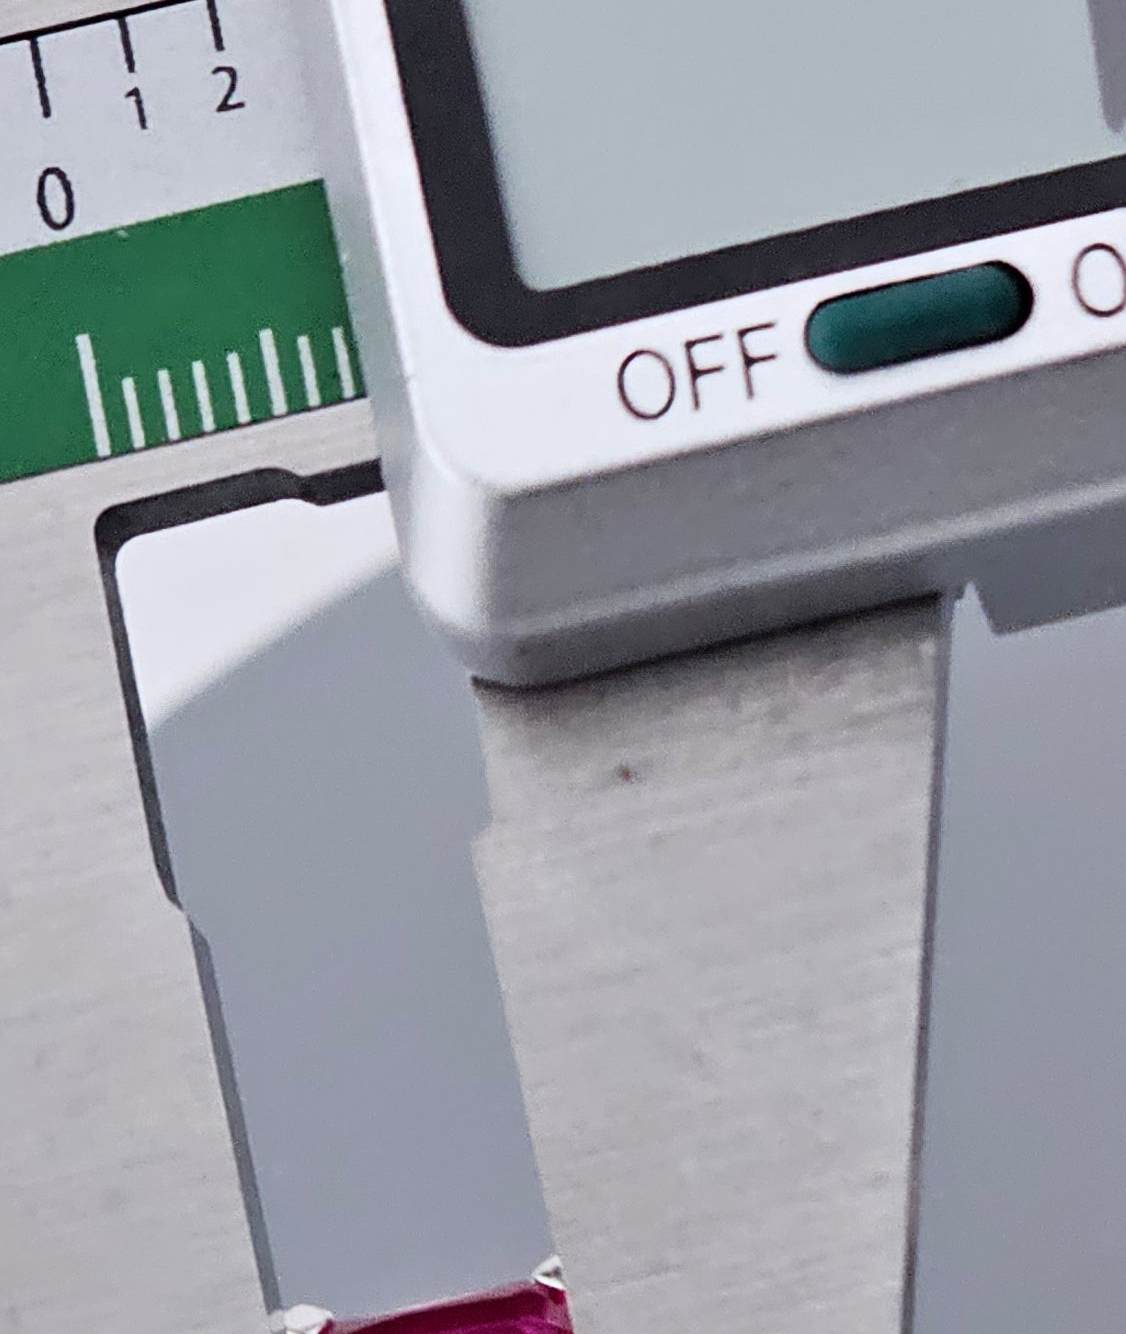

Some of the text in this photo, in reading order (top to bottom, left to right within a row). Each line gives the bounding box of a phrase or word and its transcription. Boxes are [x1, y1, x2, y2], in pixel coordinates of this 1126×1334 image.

[124, 66, 245, 129] 1 2
[36, 167, 75, 230] 0
[617, 322, 777, 420] OFF
